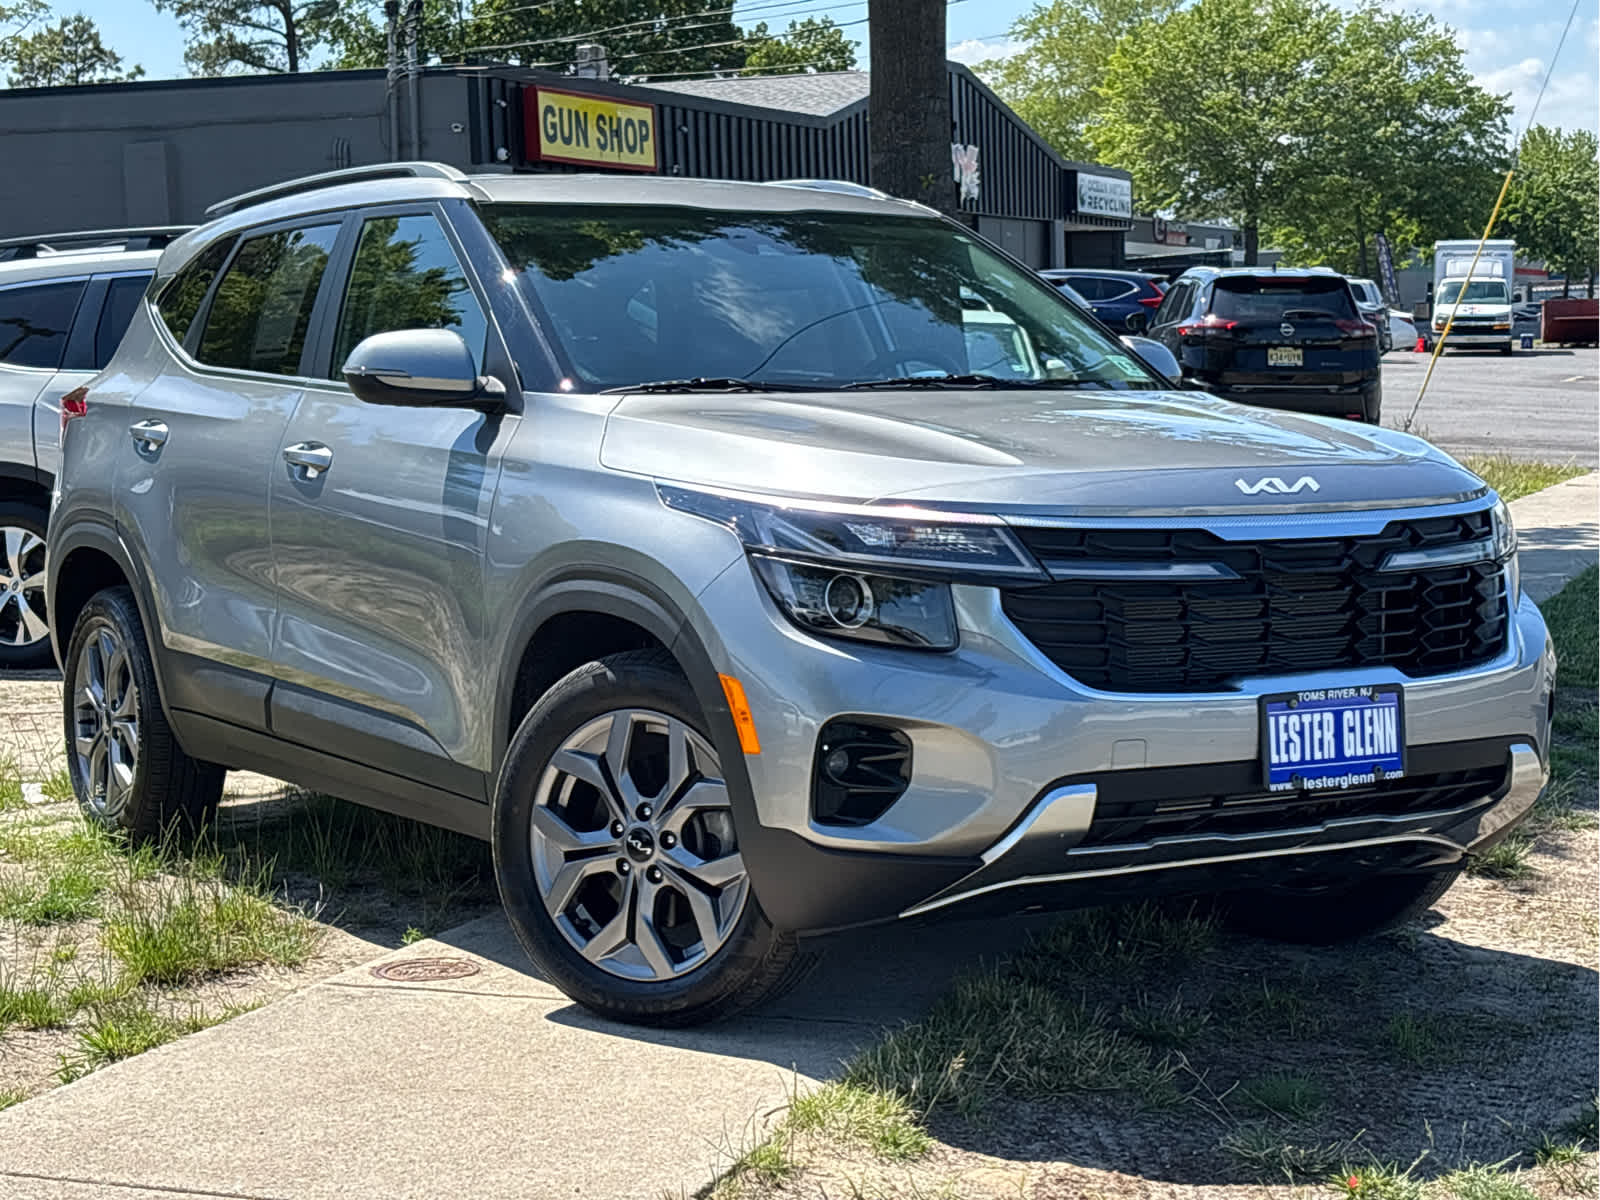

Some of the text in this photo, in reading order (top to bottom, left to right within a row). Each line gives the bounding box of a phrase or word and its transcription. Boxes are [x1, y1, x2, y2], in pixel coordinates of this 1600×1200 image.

[543, 104, 650, 155] GUN SHOP
[1087, 194, 1130, 214] RECYCLING
[1234, 476, 1321, 495] KIA
[1297, 690, 1326, 703] TOMS
[1360, 687, 1373, 697] NJ
[1269, 706, 1398, 764] LESTER GLENN
[1303, 773, 1376, 790] lesterglenn
